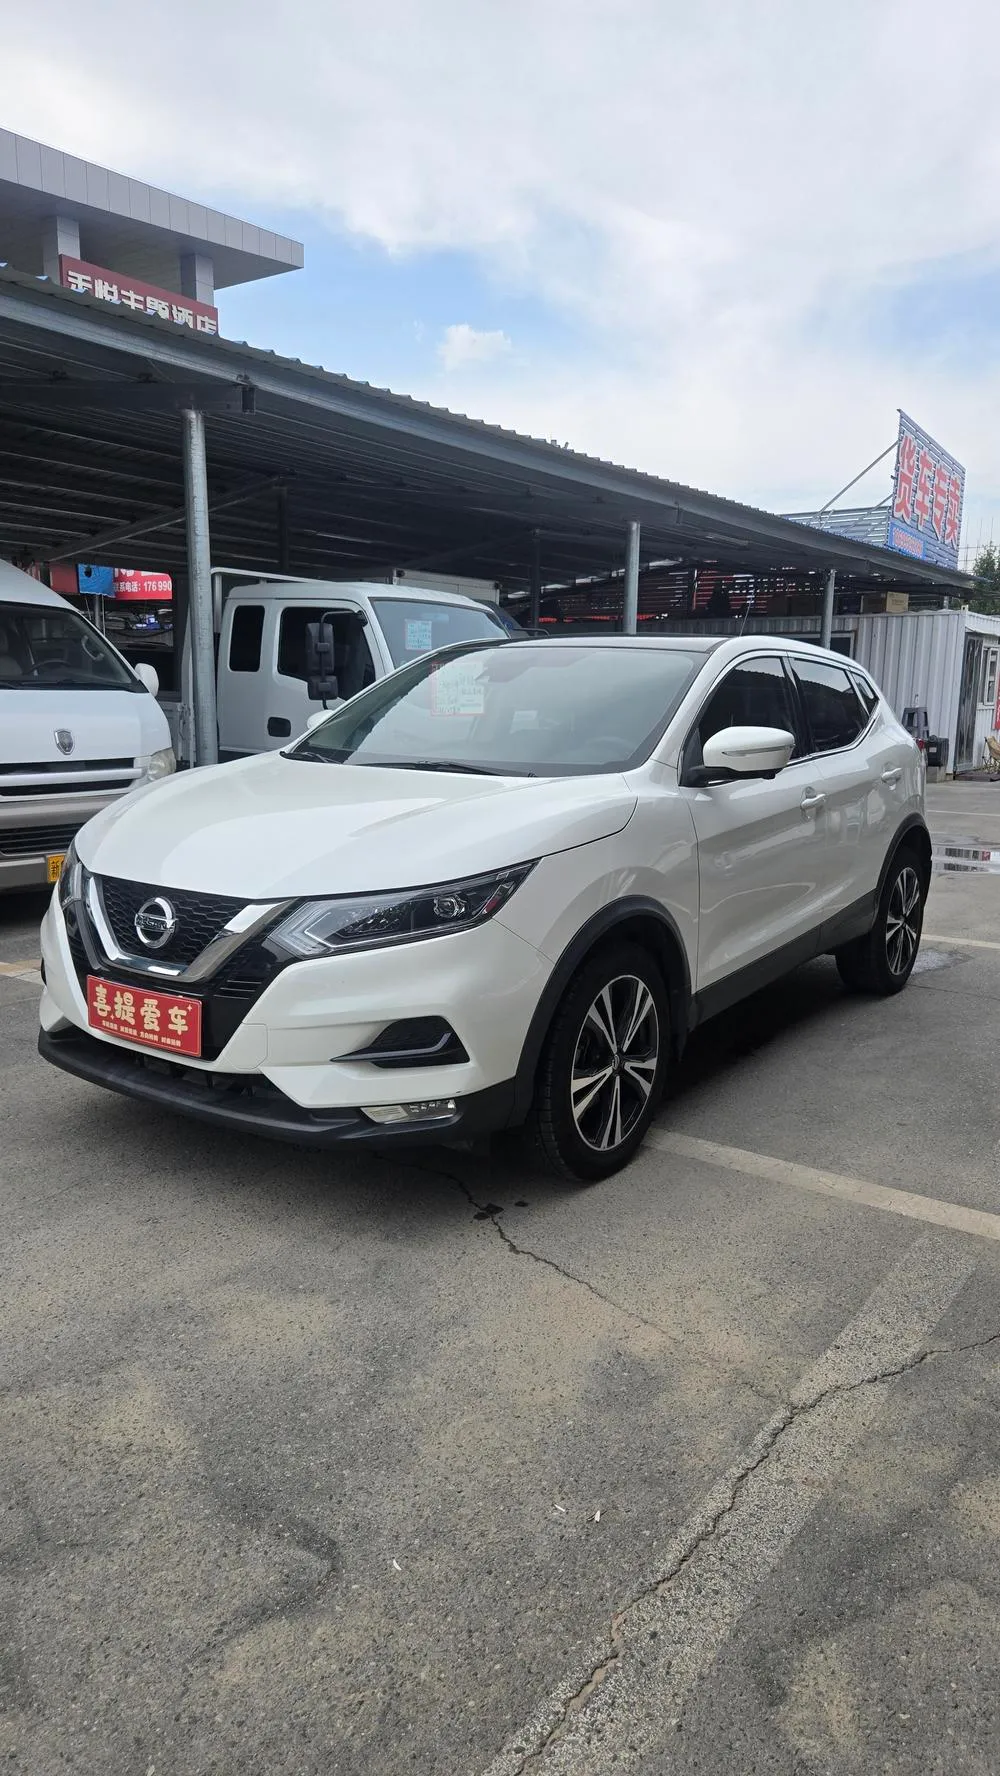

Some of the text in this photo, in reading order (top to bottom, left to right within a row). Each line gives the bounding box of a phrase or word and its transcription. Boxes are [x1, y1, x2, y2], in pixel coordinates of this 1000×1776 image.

[894, 431, 960, 550] 货车专卖
[93, 984, 189, 1035] 喜提爱车
